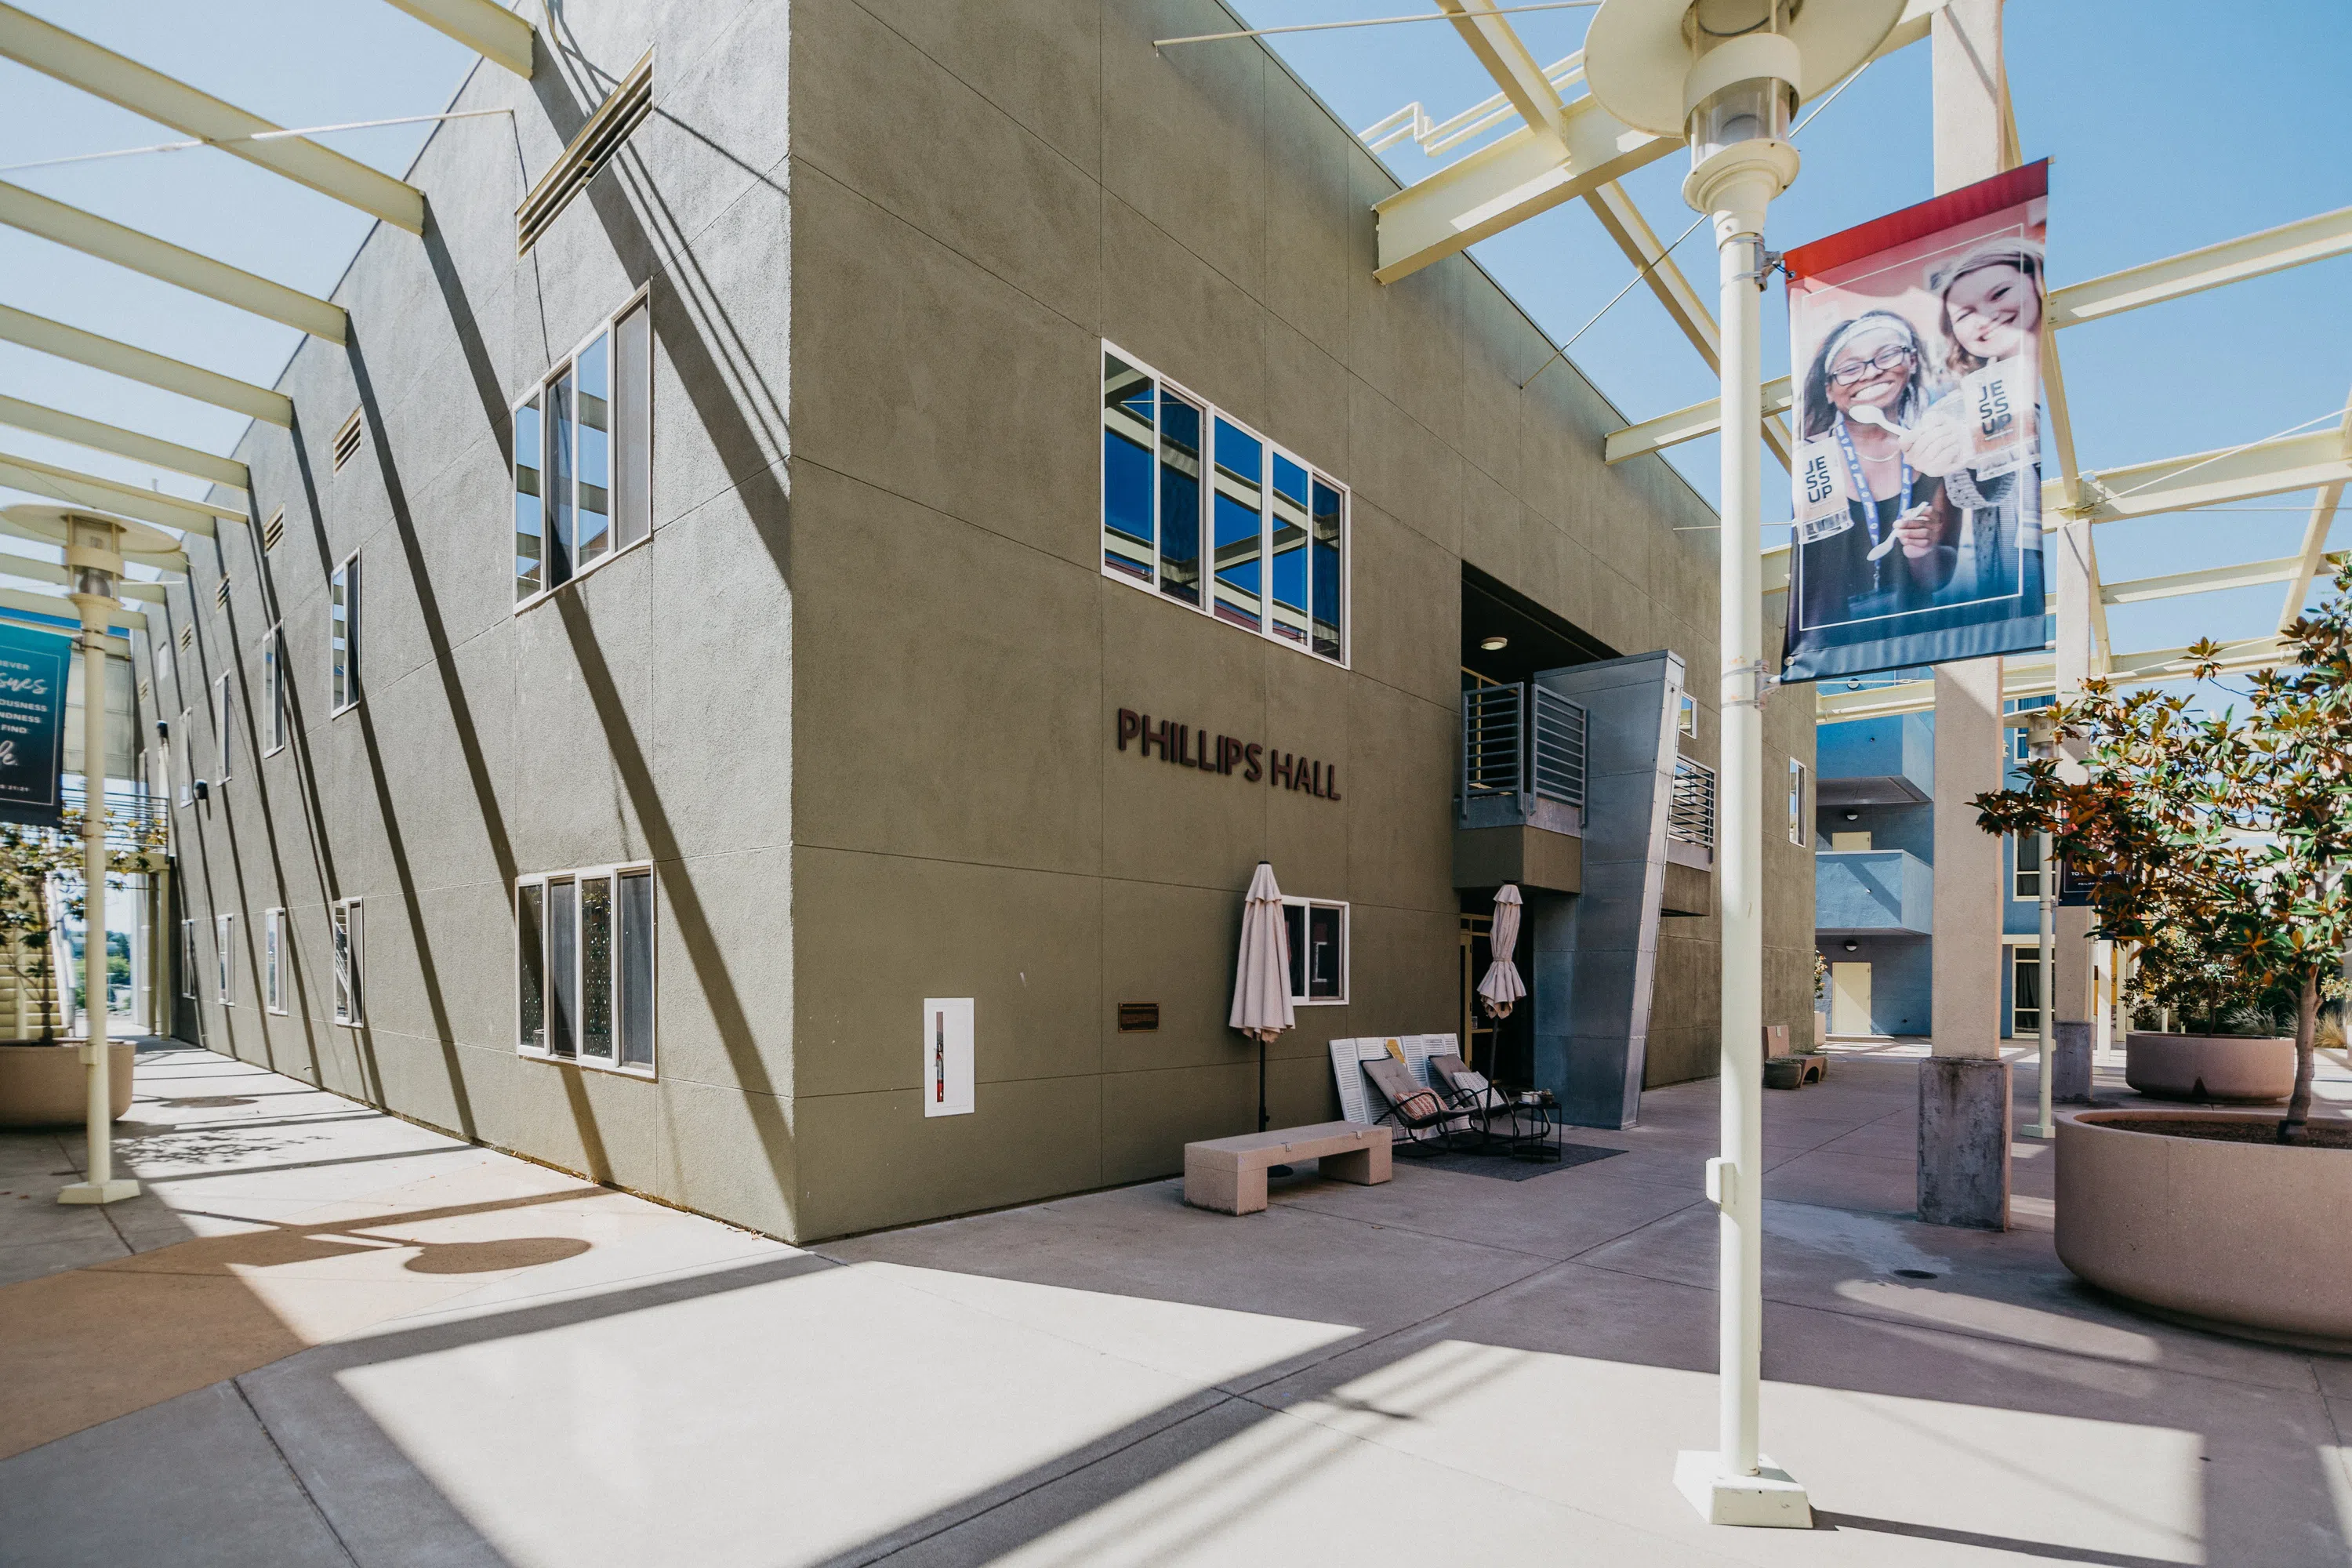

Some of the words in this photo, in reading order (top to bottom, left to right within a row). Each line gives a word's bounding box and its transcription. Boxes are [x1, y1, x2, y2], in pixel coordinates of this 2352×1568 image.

[1, 724, 27, 734] FIND
[1119, 708, 1264, 782] PHILLIPS
[1270, 749, 1341, 801] HALL
